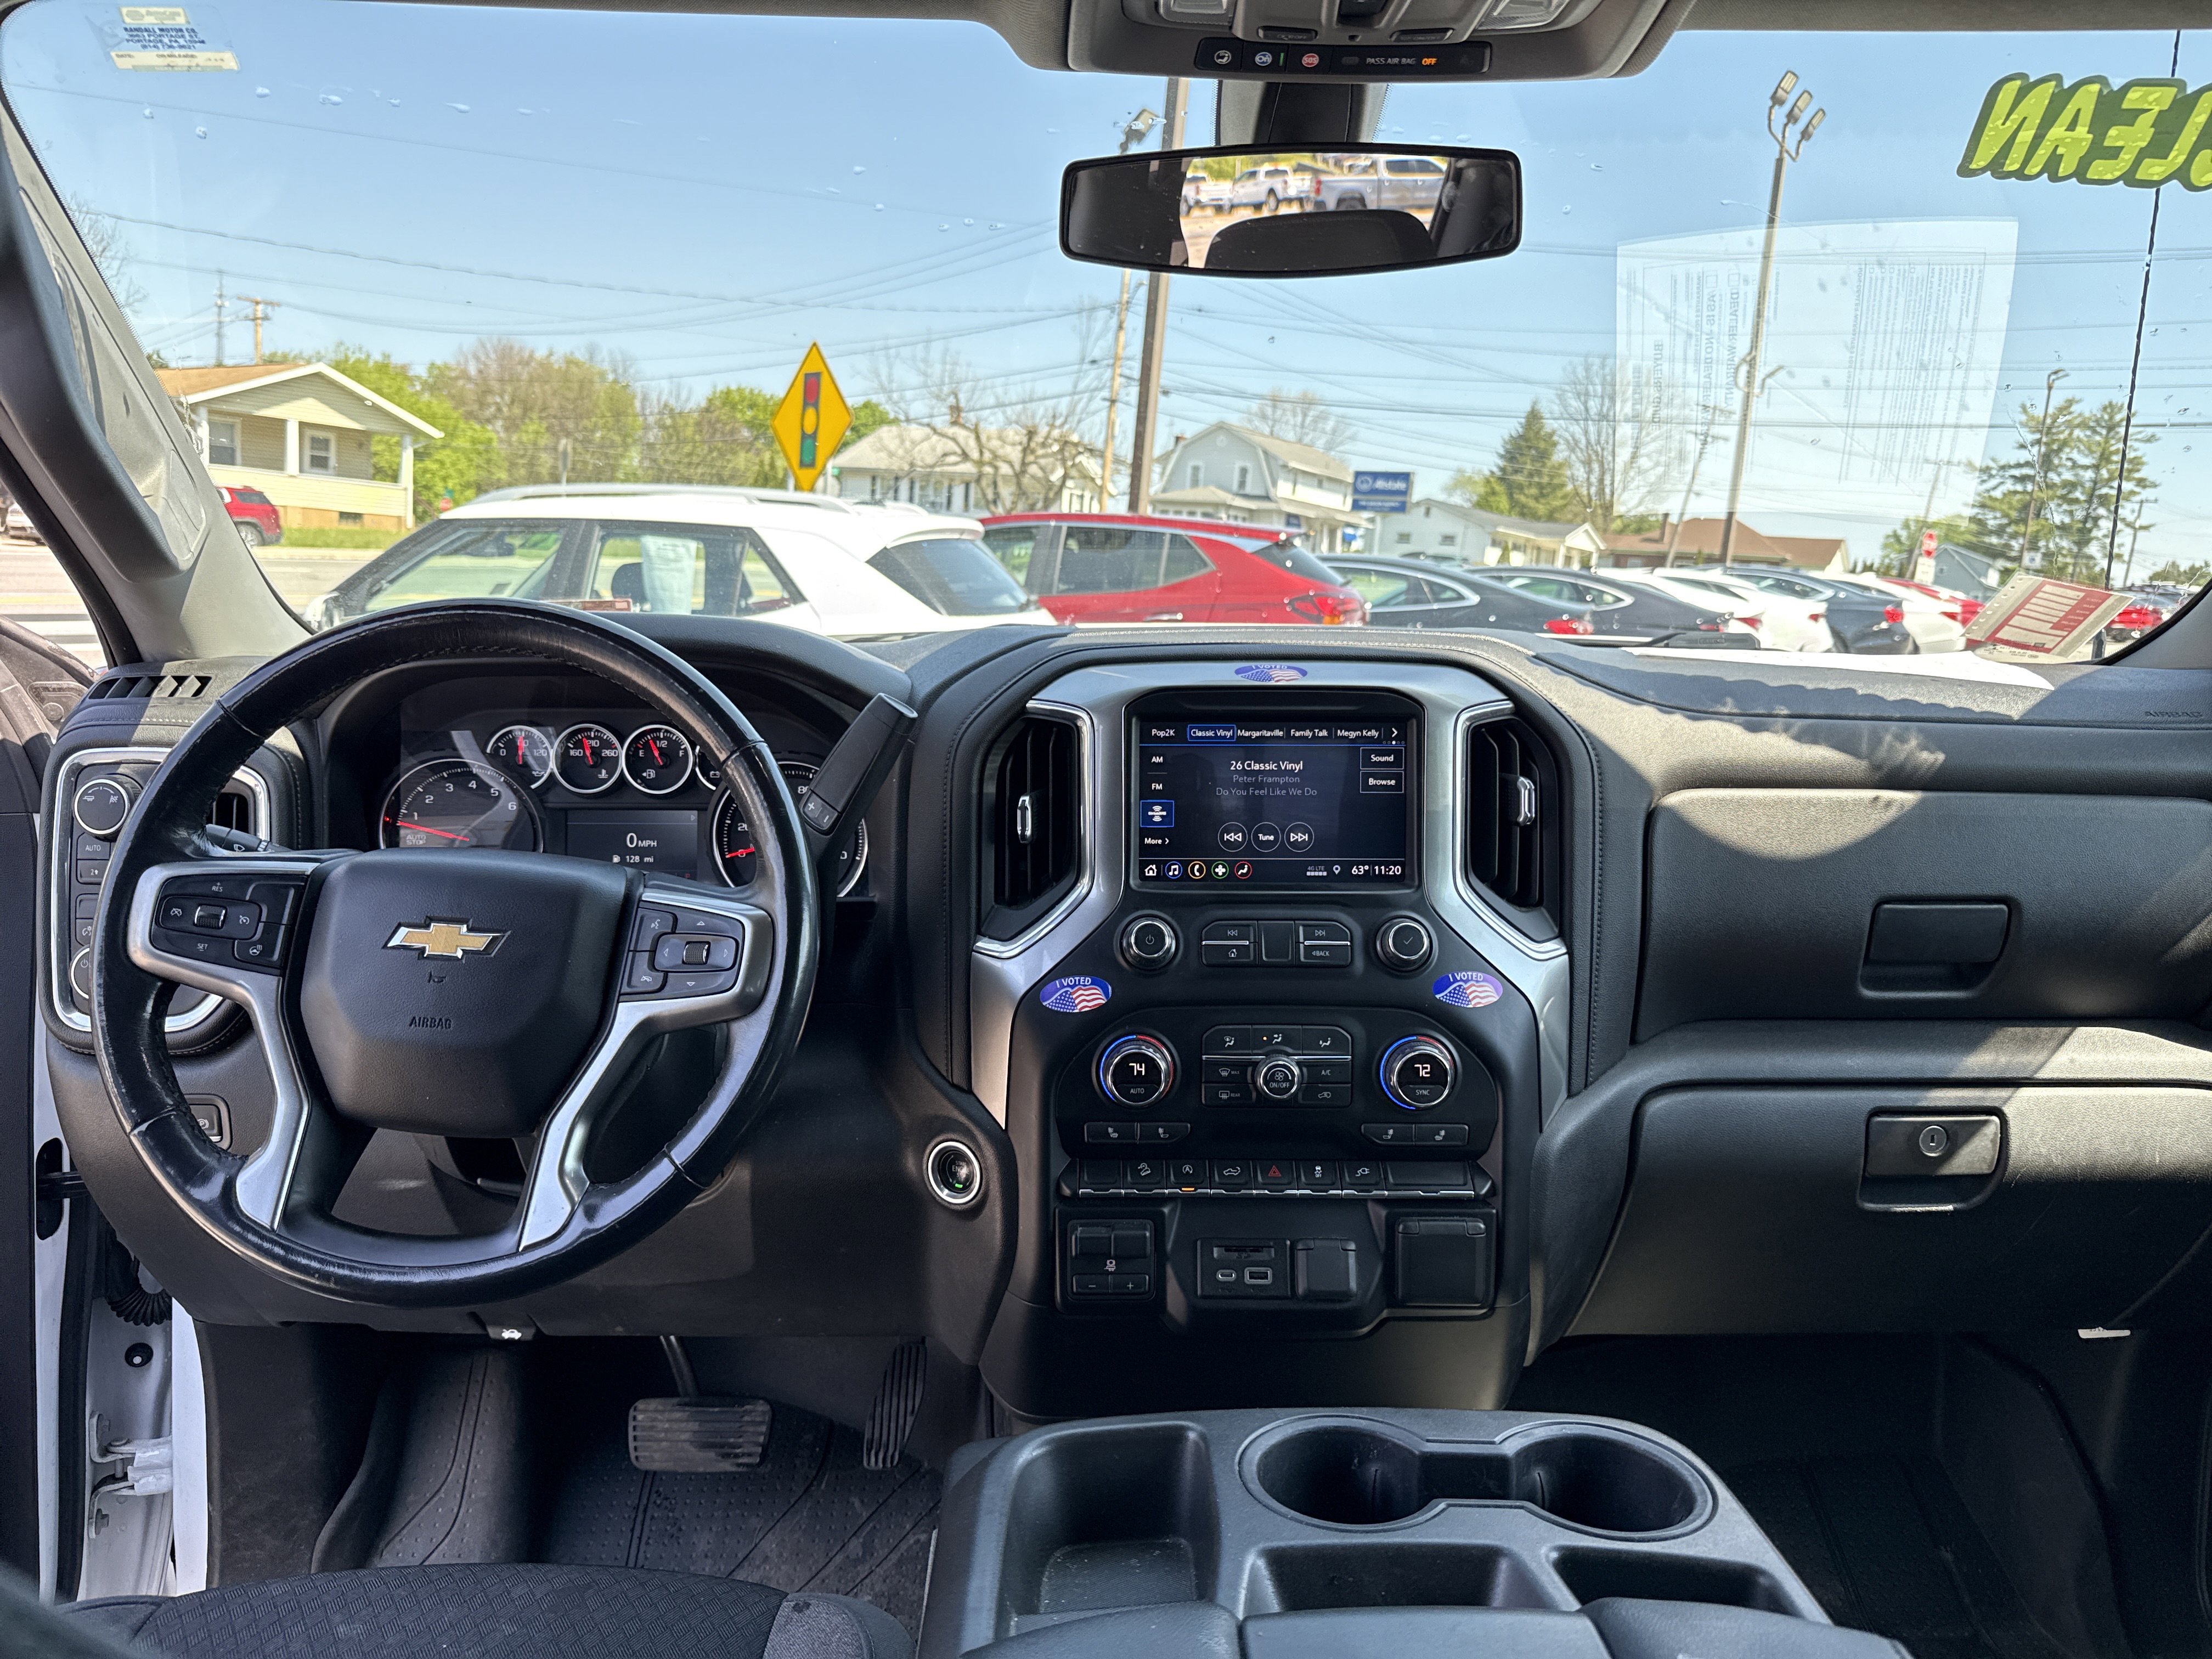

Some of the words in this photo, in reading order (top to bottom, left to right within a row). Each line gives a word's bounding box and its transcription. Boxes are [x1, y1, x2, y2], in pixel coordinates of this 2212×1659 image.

[1152, 729, 1175, 737] Pop2K
[1216, 729, 1233, 738] Vinyl
[1237, 729, 1283, 738] Margaritaville
[1290, 729, 1311, 738] Family
[1312, 729, 1328, 737] Talk
[1337, 729, 1360, 738] Megyn
[1362, 729, 1379, 738] Kelly
[1230, 761, 1243, 770] 26
[1244, 760, 1278, 770] Classic
[1279, 760, 1303, 772] Vinyl
[468, 780, 477, 789] 4
[1233, 775, 1256, 783] Peter
[1258, 775, 1300, 785] Frampton
[1368, 778, 1396, 786] Browse
[445, 783, 454, 792] 3
[1216, 788, 1228, 796] Do
[1230, 788, 1247, 796] You
[1249, 787, 1267, 796] Feel
[1269, 787, 1286, 796] Like
[1288, 788, 1303, 796] We
[1305, 788, 1317, 796] Do
[490, 788, 499, 797] 5
[425, 795, 433, 804] 2
[508, 802, 517, 810] 6
[627, 833, 636, 848] 0
[638, 839, 657, 848] MPH
[625, 855, 640, 864] 128
[644, 855, 653, 864] mi
[1351, 865, 1369, 875] 63°
[1374, 865, 1402, 875] 11:20
[1448, 973, 1453, 982] I
[1454, 972, 1484, 981] VOTED
[1056, 979, 1059, 988] I
[1061, 977, 1092, 986] VOTED
[409, 1017, 452, 1030] AIRBAG
[1128, 1063, 1146, 1076] 74
[1414, 1064, 1431, 1077] 72
